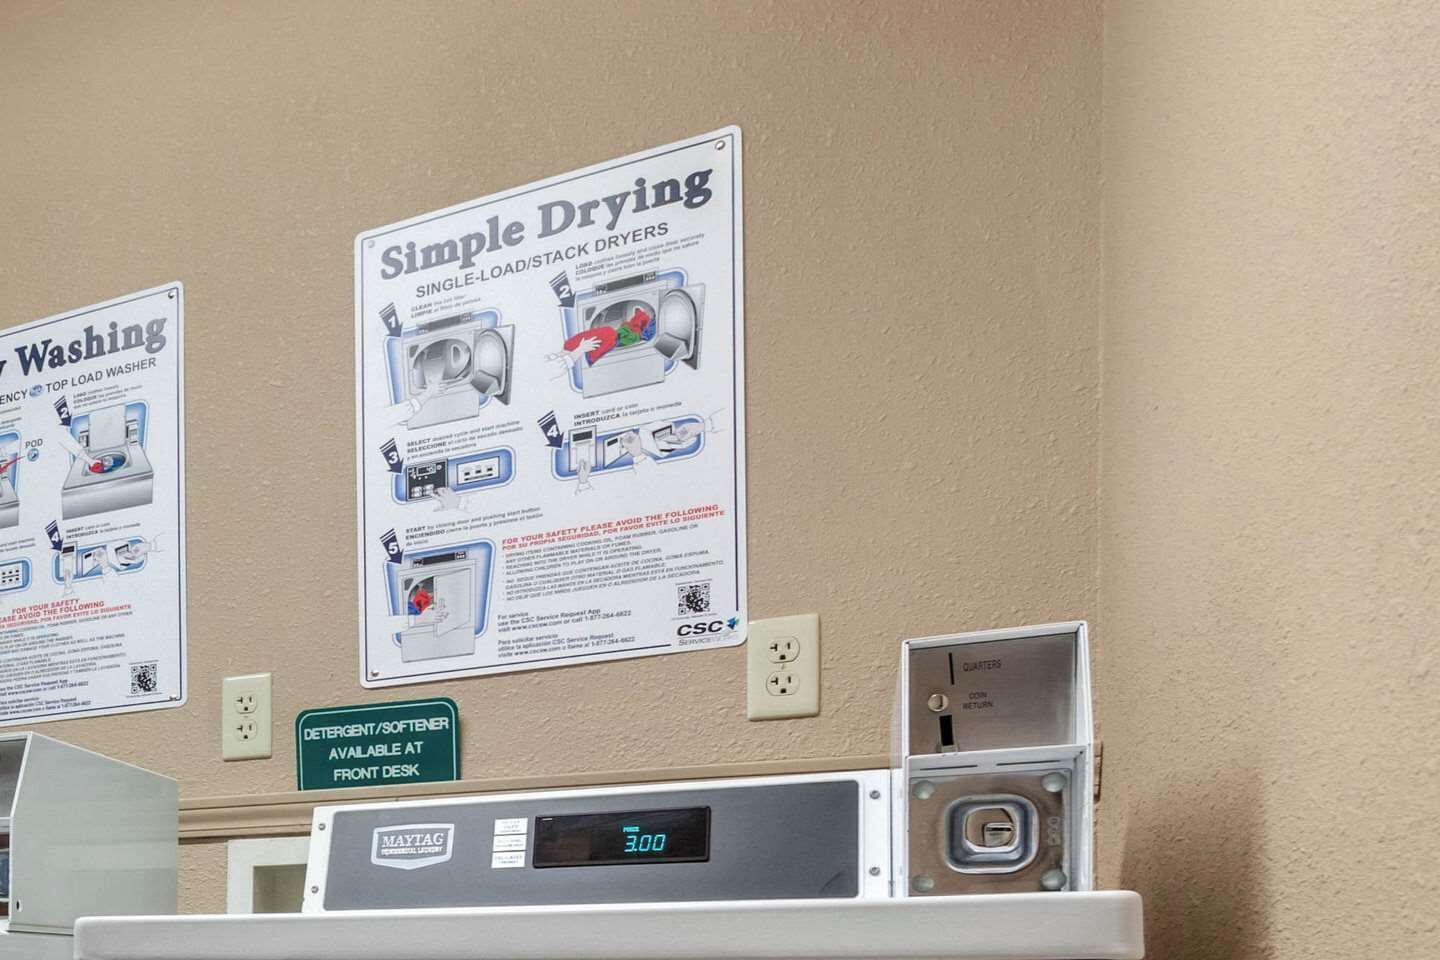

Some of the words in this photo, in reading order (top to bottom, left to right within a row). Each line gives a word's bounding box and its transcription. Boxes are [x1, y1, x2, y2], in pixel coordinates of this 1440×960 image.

[380, 215, 525, 280] Simple
[537, 168, 714, 239] Drying
[415, 242, 588, 299] SINGLE-LOAD/STACK
[596, 221, 669, 253] DRYERS
[559, 284, 572, 297] 2
[388, 315, 399, 329] 1
[15, 318, 167, 376] Washing
[45, 378, 69, 393] TOP
[71, 370, 103, 387] LOAD
[106, 357, 157, 378] WASHER
[60, 406, 69, 418] 2
[574, 410, 599, 419] INSERT
[574, 412, 619, 426] INTRODUZCA
[547, 425, 559, 438] 4
[25, 438, 44, 449] POD
[407, 438, 430, 447] SELECT
[407, 441, 446, 453] SELECCIONE
[388, 452, 398, 464] 3
[405, 525, 425, 533] START
[502, 537, 517, 545] FOR
[521, 533, 543, 541] YOUR
[545, 527, 576, 537] SAFETY
[581, 521, 613, 532] PLEASE
[615, 516, 641, 526] AVOID
[646, 513, 663, 521] THE
[665, 504, 718, 518] FOLLOWING
[530, 537, 555, 546] PROPIA
[619, 523, 643, 531] FAVOR
[646, 519, 668, 527] EVITE
[683, 510, 724, 521] SIGUIENTE
[389, 542, 399, 554] 5
[18, 611, 40, 619] AVOID
[59, 600, 104, 613] FOLLOWING
[29, 603, 48, 611] YOUR
[51, 598, 79, 607] SAFETY
[536, 613, 558, 622] Service
[560, 610, 585, 618] Request
[677, 620, 723, 636] CSC
[963, 659, 1001, 672] QUARTERS
[304, 717, 449, 740] DETERGENT/SOFTENER
[329, 743, 402, 760] AVAILABLE
[404, 741, 424, 754] AT
[334, 767, 379, 781] FRONT
[382, 764, 420, 778] DESK
[382, 833, 444, 847] MAYTAG
[624, 834, 667, 852] 3.00
